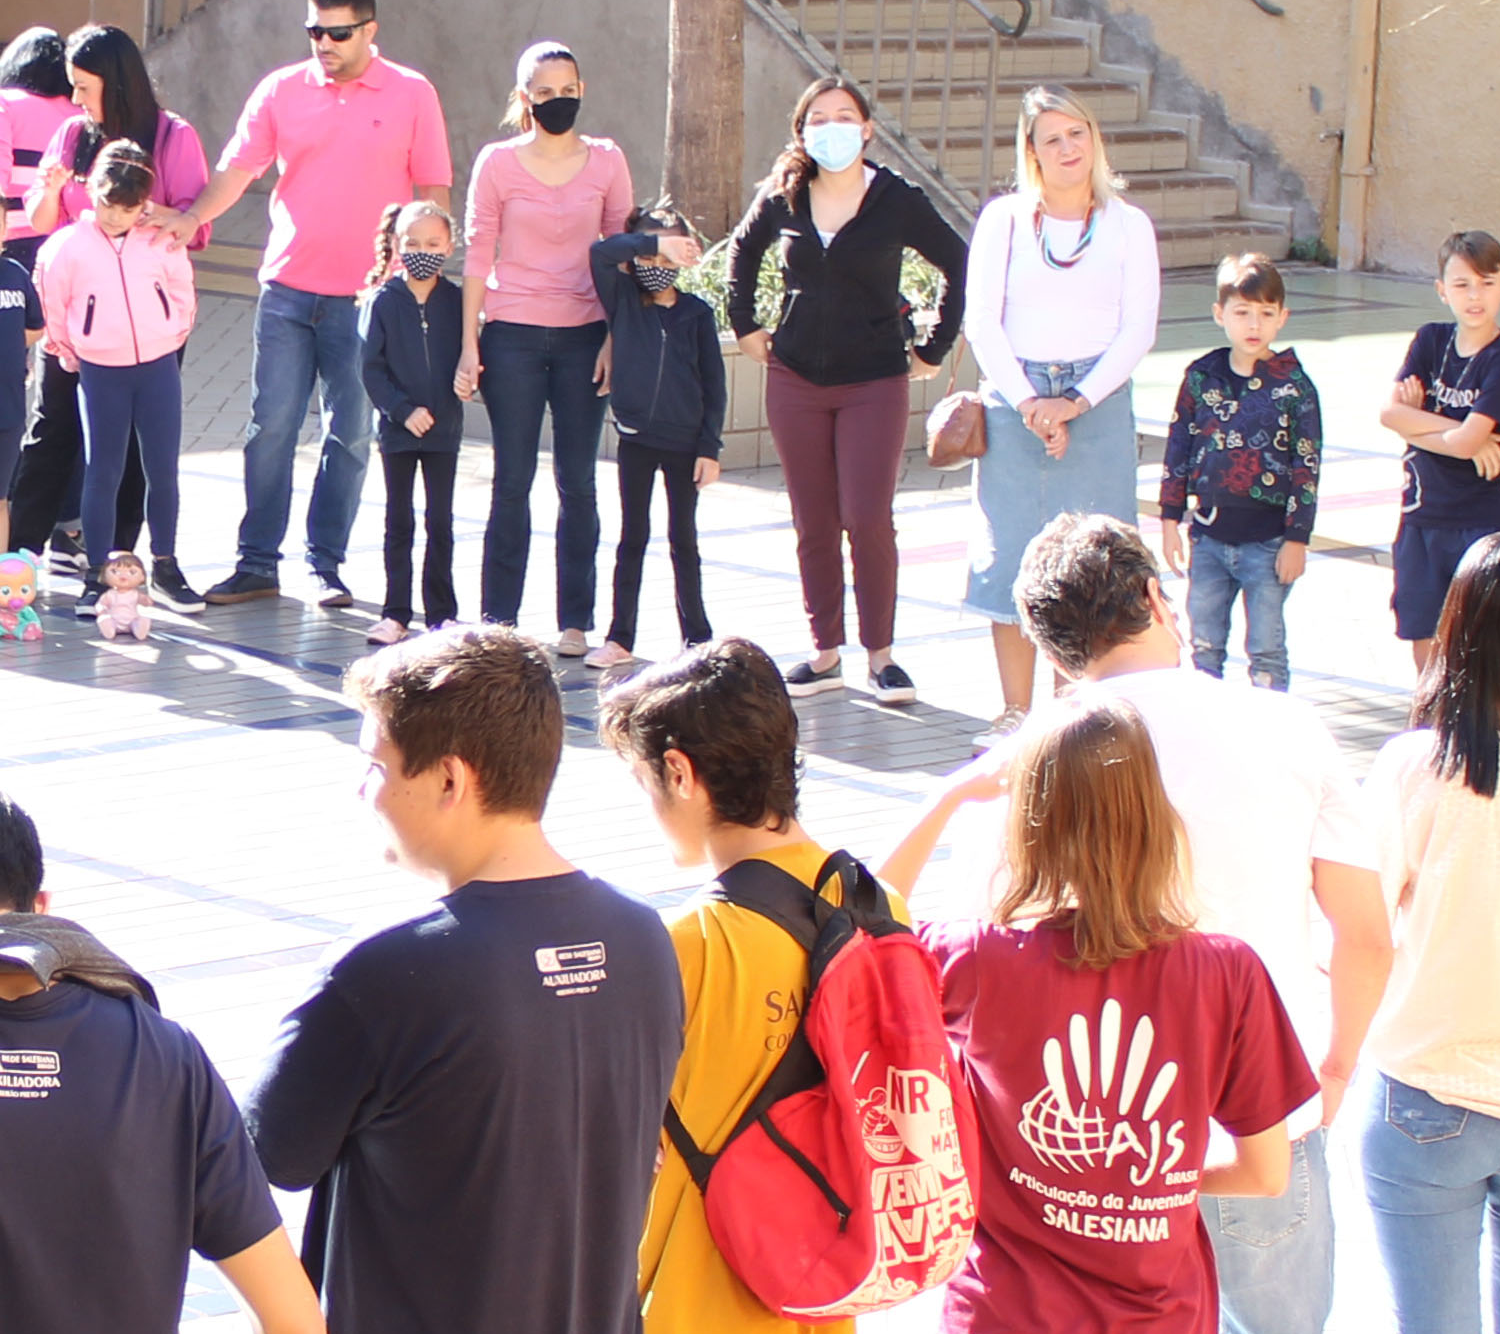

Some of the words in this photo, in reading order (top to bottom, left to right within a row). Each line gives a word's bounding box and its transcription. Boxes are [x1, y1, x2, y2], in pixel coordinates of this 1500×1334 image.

[542, 969, 607, 987] AUXILIADORA
[1103, 1120, 1186, 1188] AJS
[1008, 1166, 1098, 1208] Articulação
[1101, 1193, 1125, 1211] da
[1041, 1202, 1171, 1243] SALESIANA
